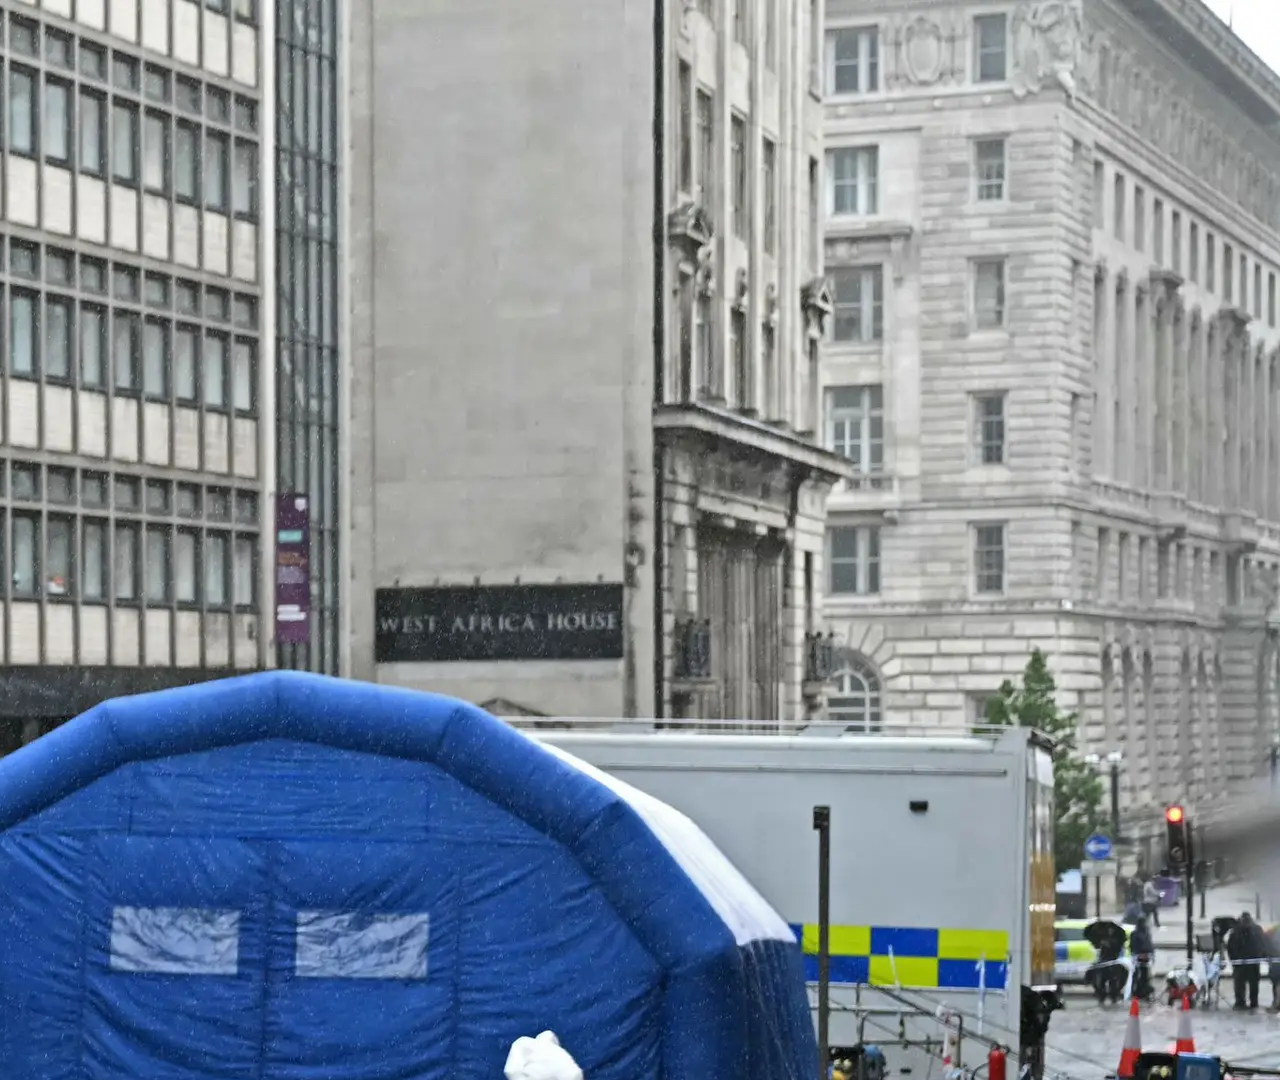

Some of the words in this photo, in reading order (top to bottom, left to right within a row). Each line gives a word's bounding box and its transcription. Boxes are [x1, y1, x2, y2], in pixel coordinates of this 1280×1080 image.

[379, 615, 438, 634] WEST
[451, 613, 536, 634] AFRICA
[547, 612, 620, 631] HOUSE
